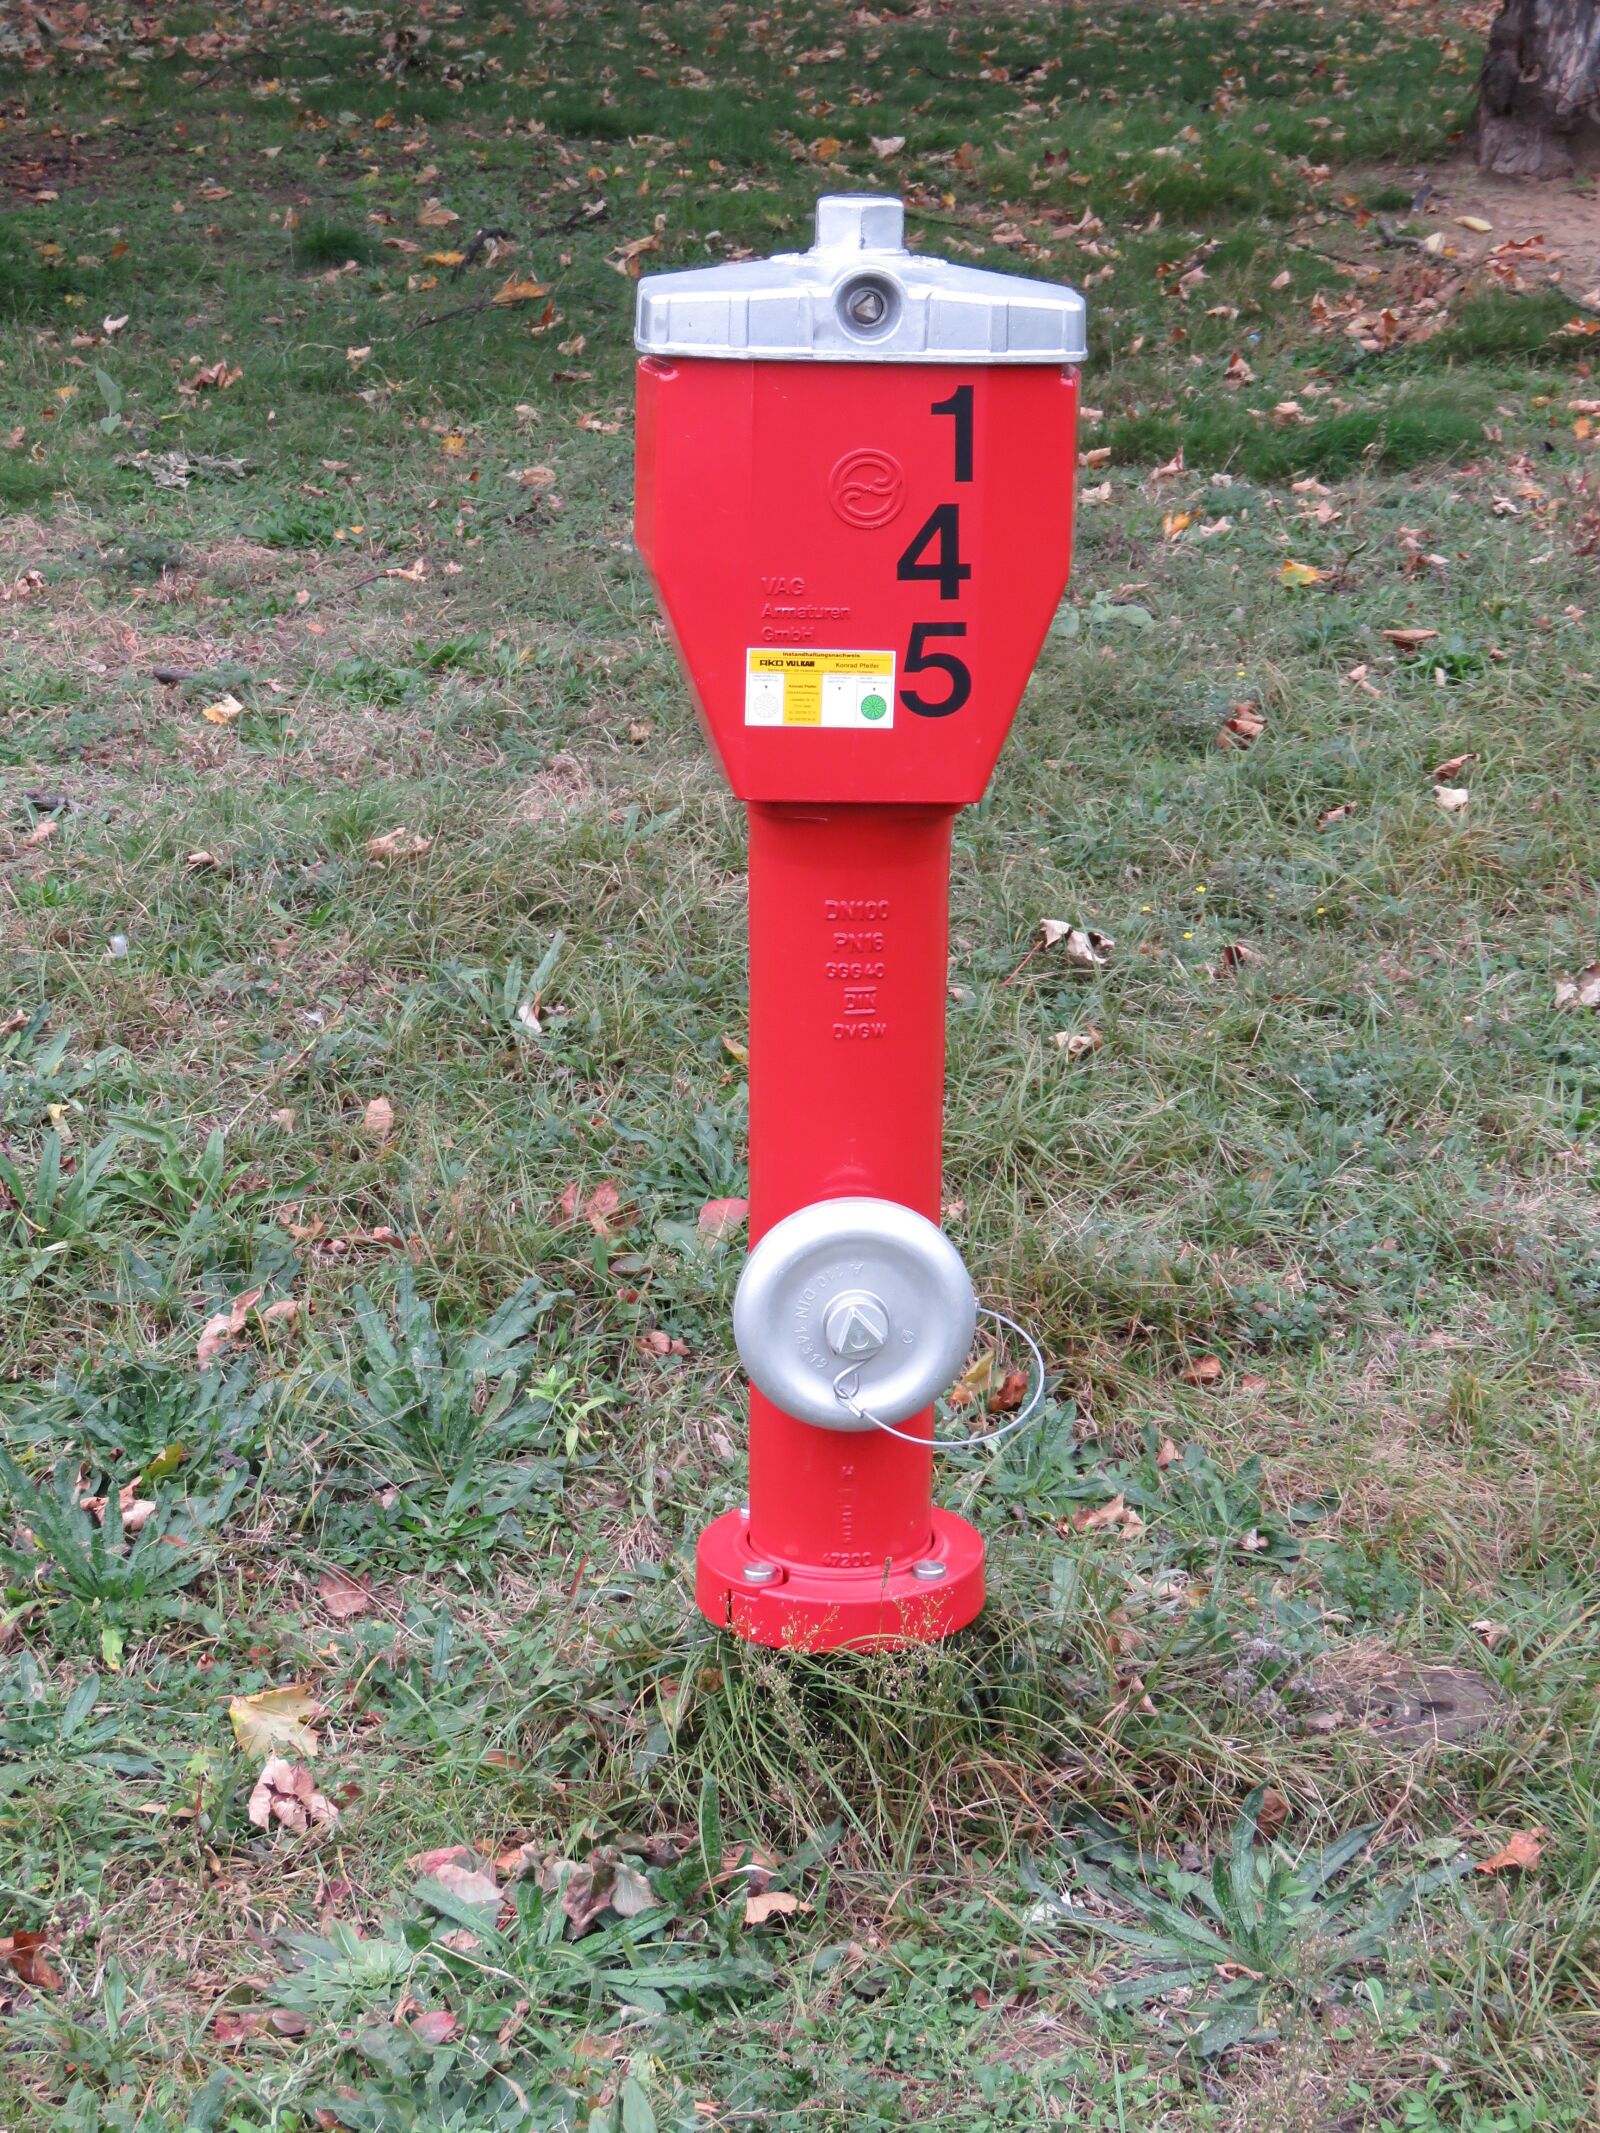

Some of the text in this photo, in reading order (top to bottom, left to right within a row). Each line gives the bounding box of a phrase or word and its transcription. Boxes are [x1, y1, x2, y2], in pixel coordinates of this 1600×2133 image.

[761, 576, 805, 596] VAG
[761, 603, 850, 620] Armaturen
[761, 626, 814, 642] GmbH
[824, 899, 889, 920] DN100
[832, 931, 884, 953] PN16
